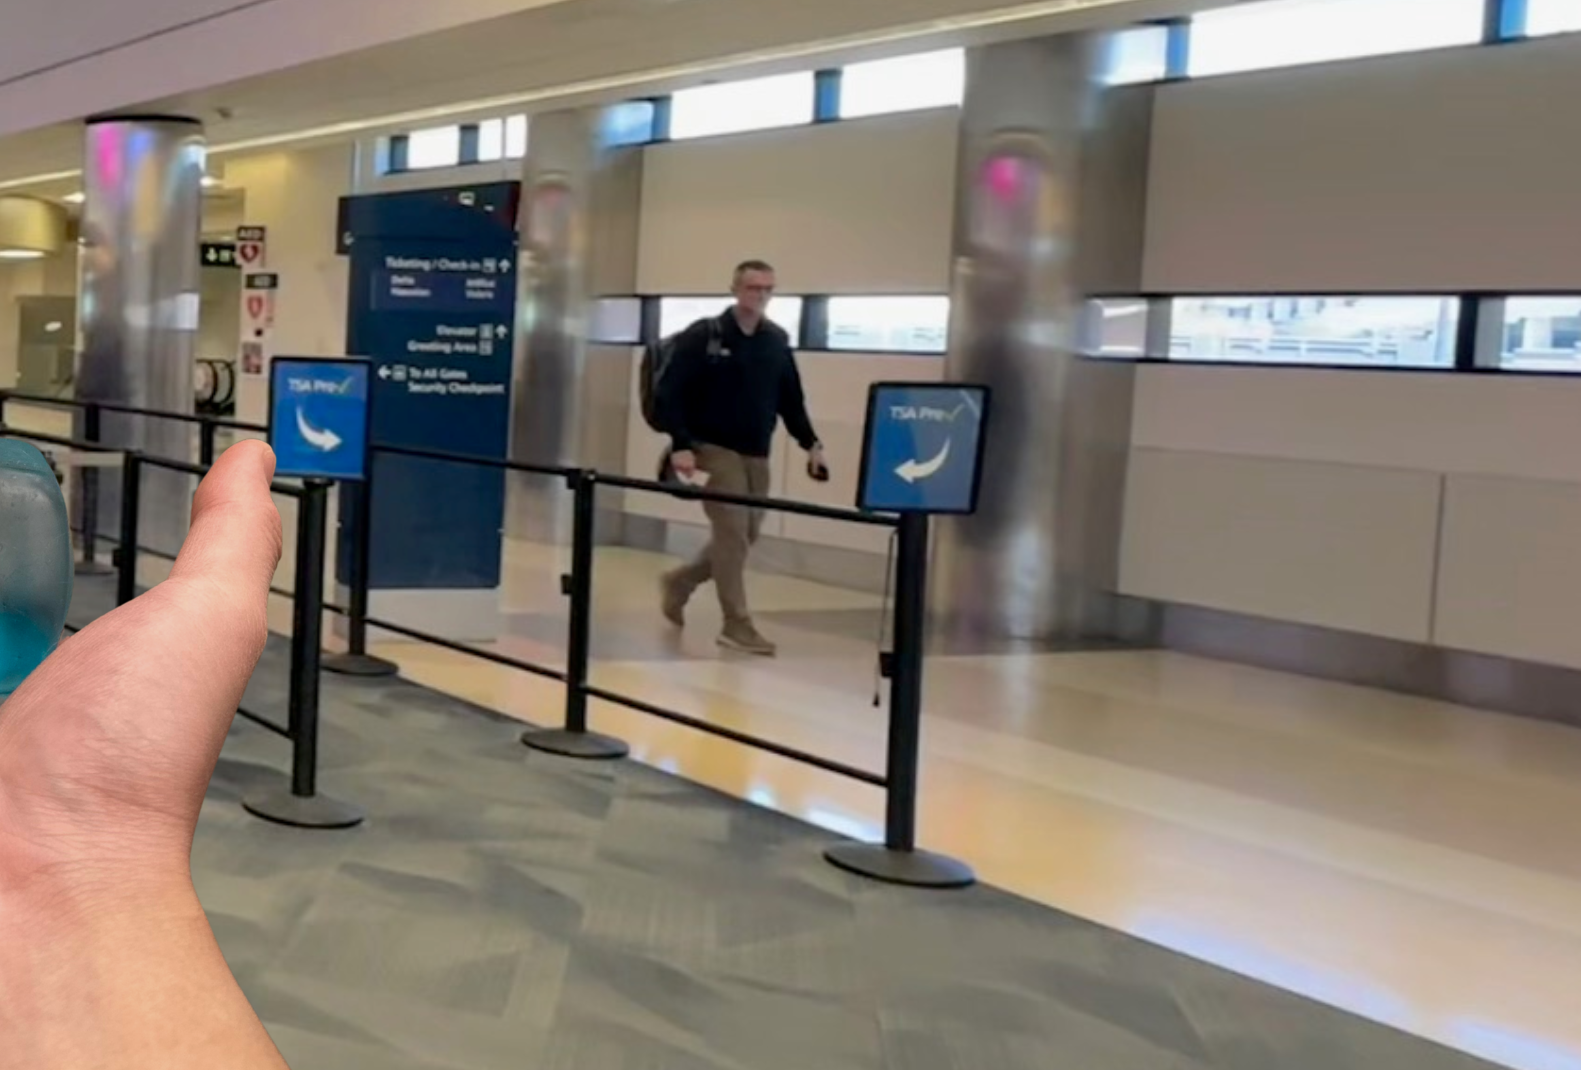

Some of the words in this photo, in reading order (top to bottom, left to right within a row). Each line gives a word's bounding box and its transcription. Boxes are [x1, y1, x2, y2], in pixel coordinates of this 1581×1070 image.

[386, 256, 432, 272] Ticketing
[408, 367, 421, 379] To
[422, 368, 438, 379] All
[288, 378, 312, 392] TSA
[889, 406, 917, 419] TSA
